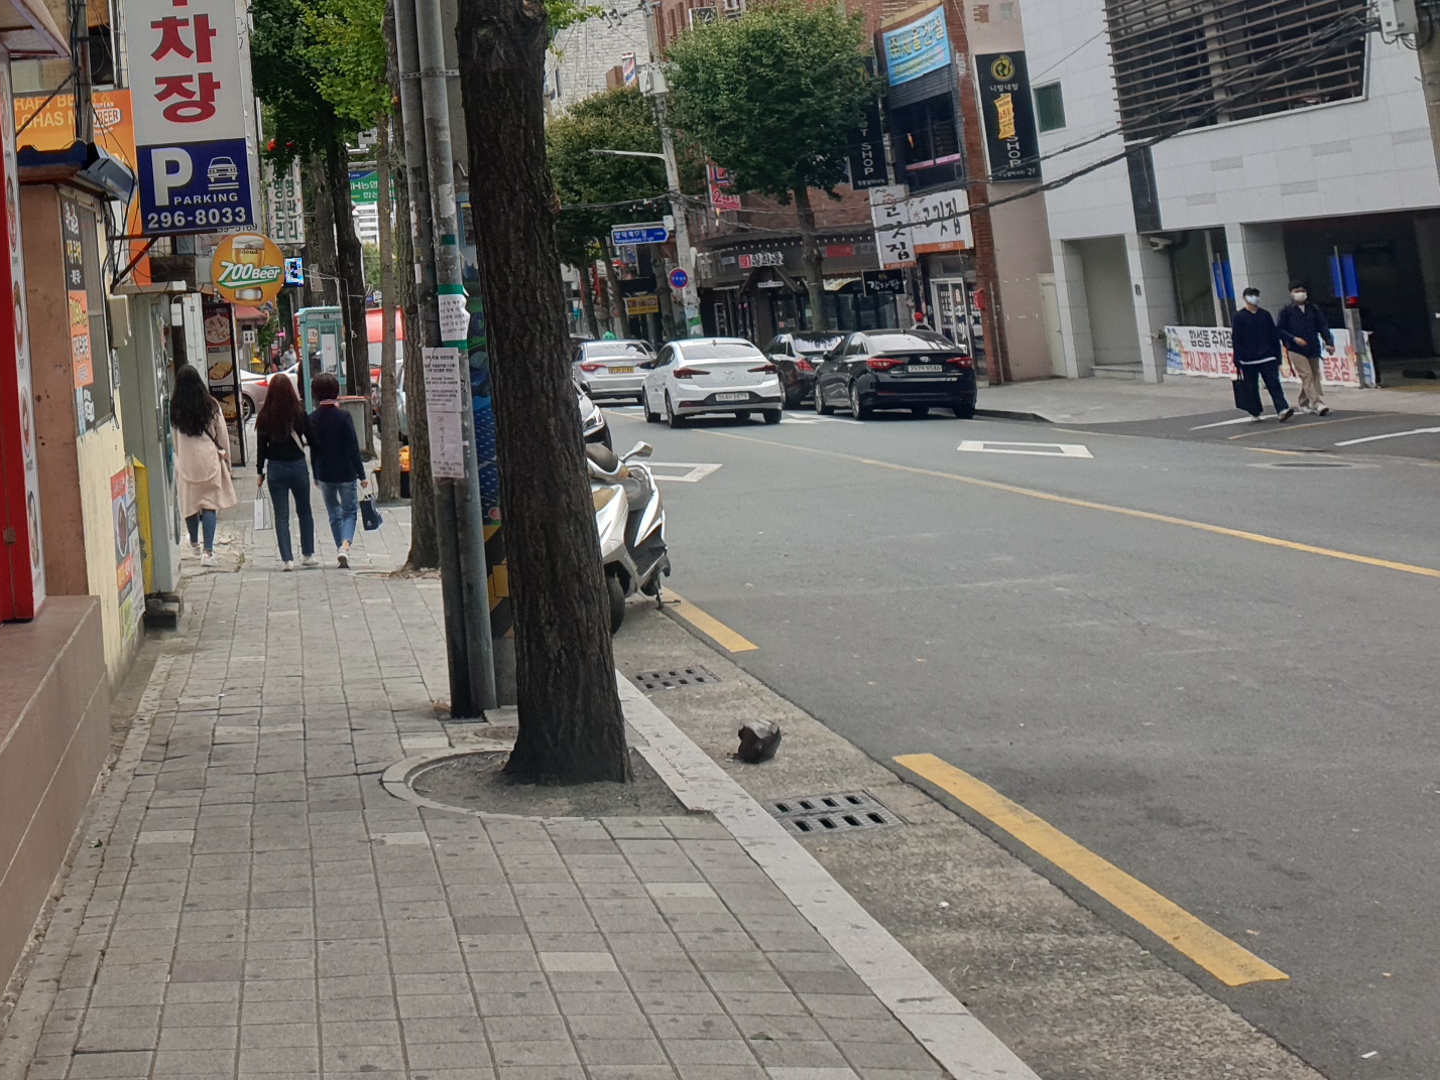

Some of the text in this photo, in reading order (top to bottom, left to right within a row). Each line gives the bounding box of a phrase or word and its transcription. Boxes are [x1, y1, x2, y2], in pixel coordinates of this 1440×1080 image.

[861, 141, 874, 176] SHOP
[151, 146, 194, 207] P
[173, 192, 239, 206] PARKING
[147, 206, 247, 229] 296-8033
